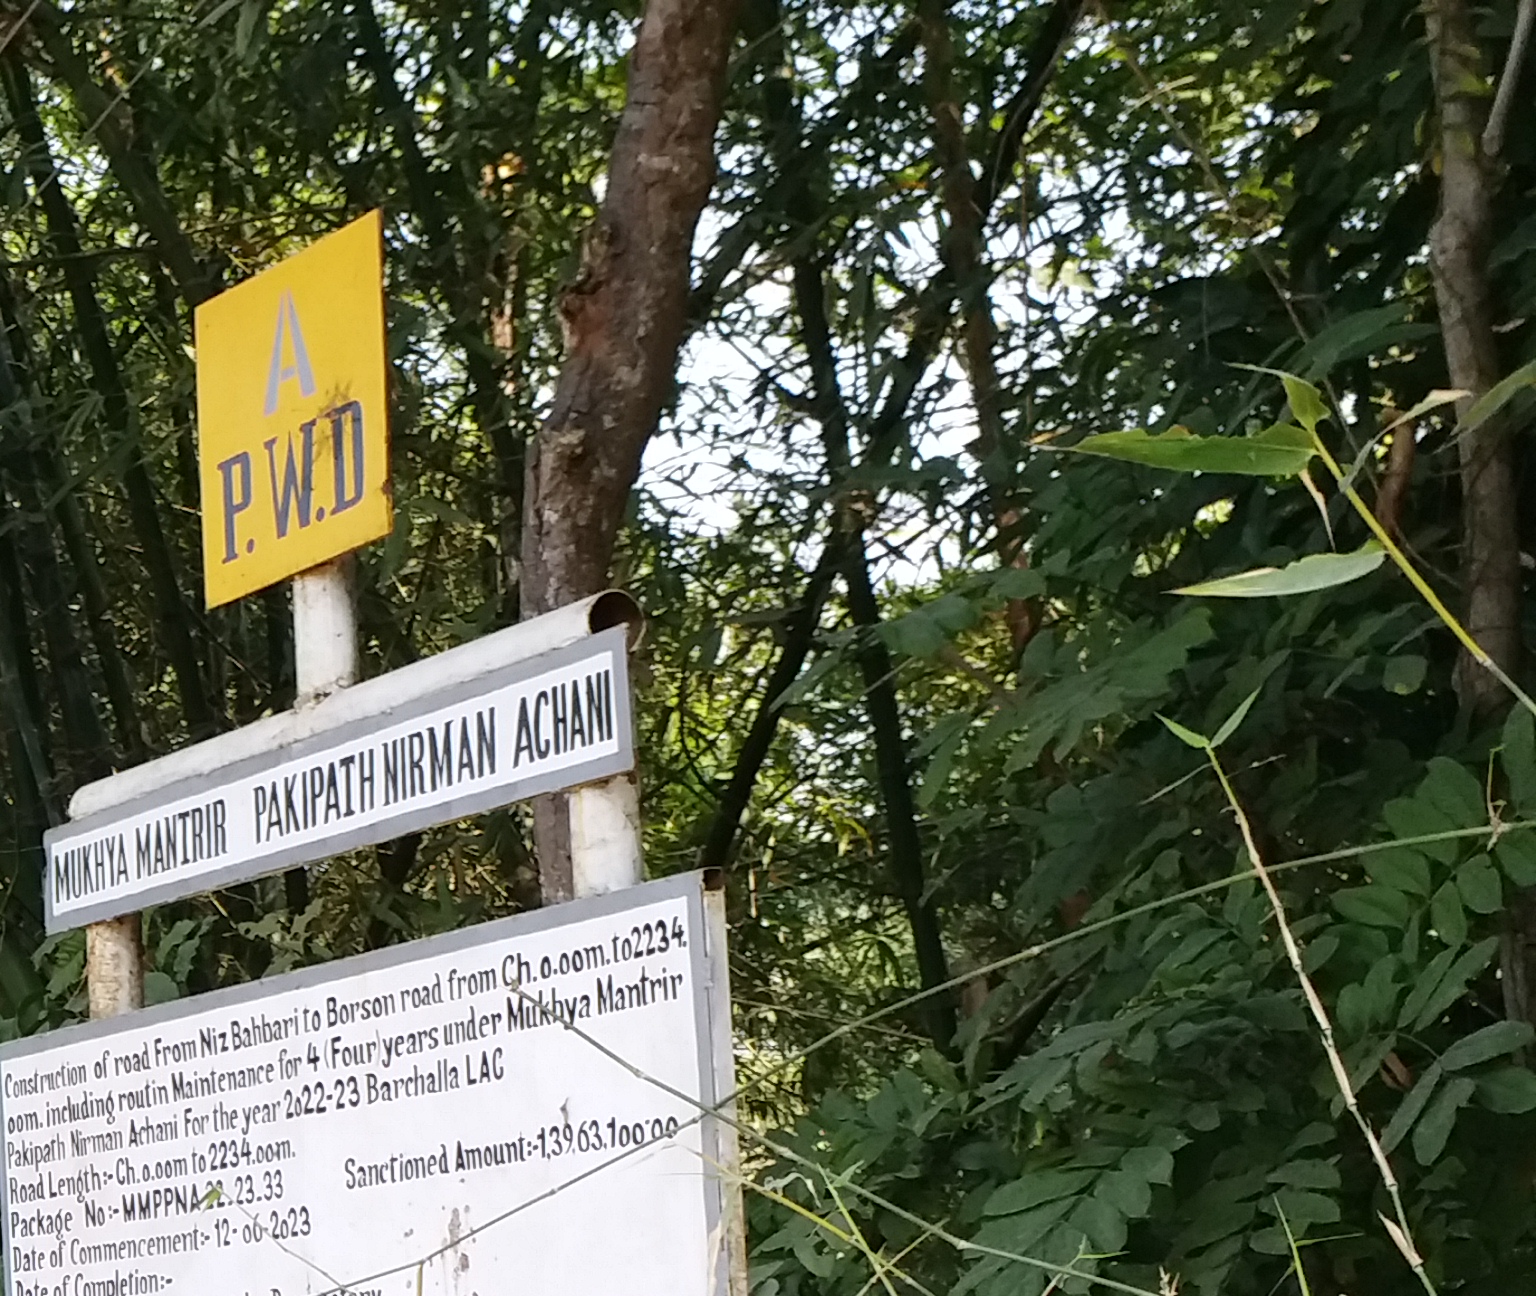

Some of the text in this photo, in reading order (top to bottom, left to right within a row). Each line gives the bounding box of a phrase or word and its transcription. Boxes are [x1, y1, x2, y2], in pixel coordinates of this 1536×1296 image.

[263, 284, 317, 417] A
[54, 669, 613, 904] MUKHYA MANTRIR PAKIPATH NIRMAN ACHANI
[5, 1061, 88, 1099] Construction
[94, 1050, 111, 1081] of
[114, 1041, 150, 1077] road
[154, 1037, 198, 1068] From
[199, 1026, 229, 1057] Niz
[231, 1007, 299, 1051] Bahbari
[303, 1008, 322, 1034] to
[327, 996, 396, 1028] Borson
[401, 973, 441, 1012] road
[448, 966, 497, 1000] from
[46, 1090, 115, 1128] including
[118, 1081, 169, 1114] routin
[171, 1061, 274, 1104] Maintenance
[278, 1049, 302, 1081] for
[306, 1042, 320, 1073] 4
[382, 1027, 439, 1068] years
[444, 1006, 502, 1046] under
[506, 988, 592, 1032] Mukhya
[596, 966, 683, 1016] Mantrir
[8, 1131, 66, 1172] Pakipath
[70, 1124, 123, 1157] Nirman
[129, 1114, 178, 1147] Achani
[184, 1107, 209, 1138] For
[213, 1101, 239, 1132] the
[241, 1104, 281, 1135] year
[366, 1059, 459, 1106] Barchalla
[466, 1047, 505, 1086] LAC
[345, 1144, 450, 1190] Sanctioned
[9, 1174, 45, 1205] Road
[192, 1147, 207, 1174] to
[11, 1208, 73, 1240] Package
[13, 1244, 45, 1273] Date
[49, 1240, 66, 1268] of
